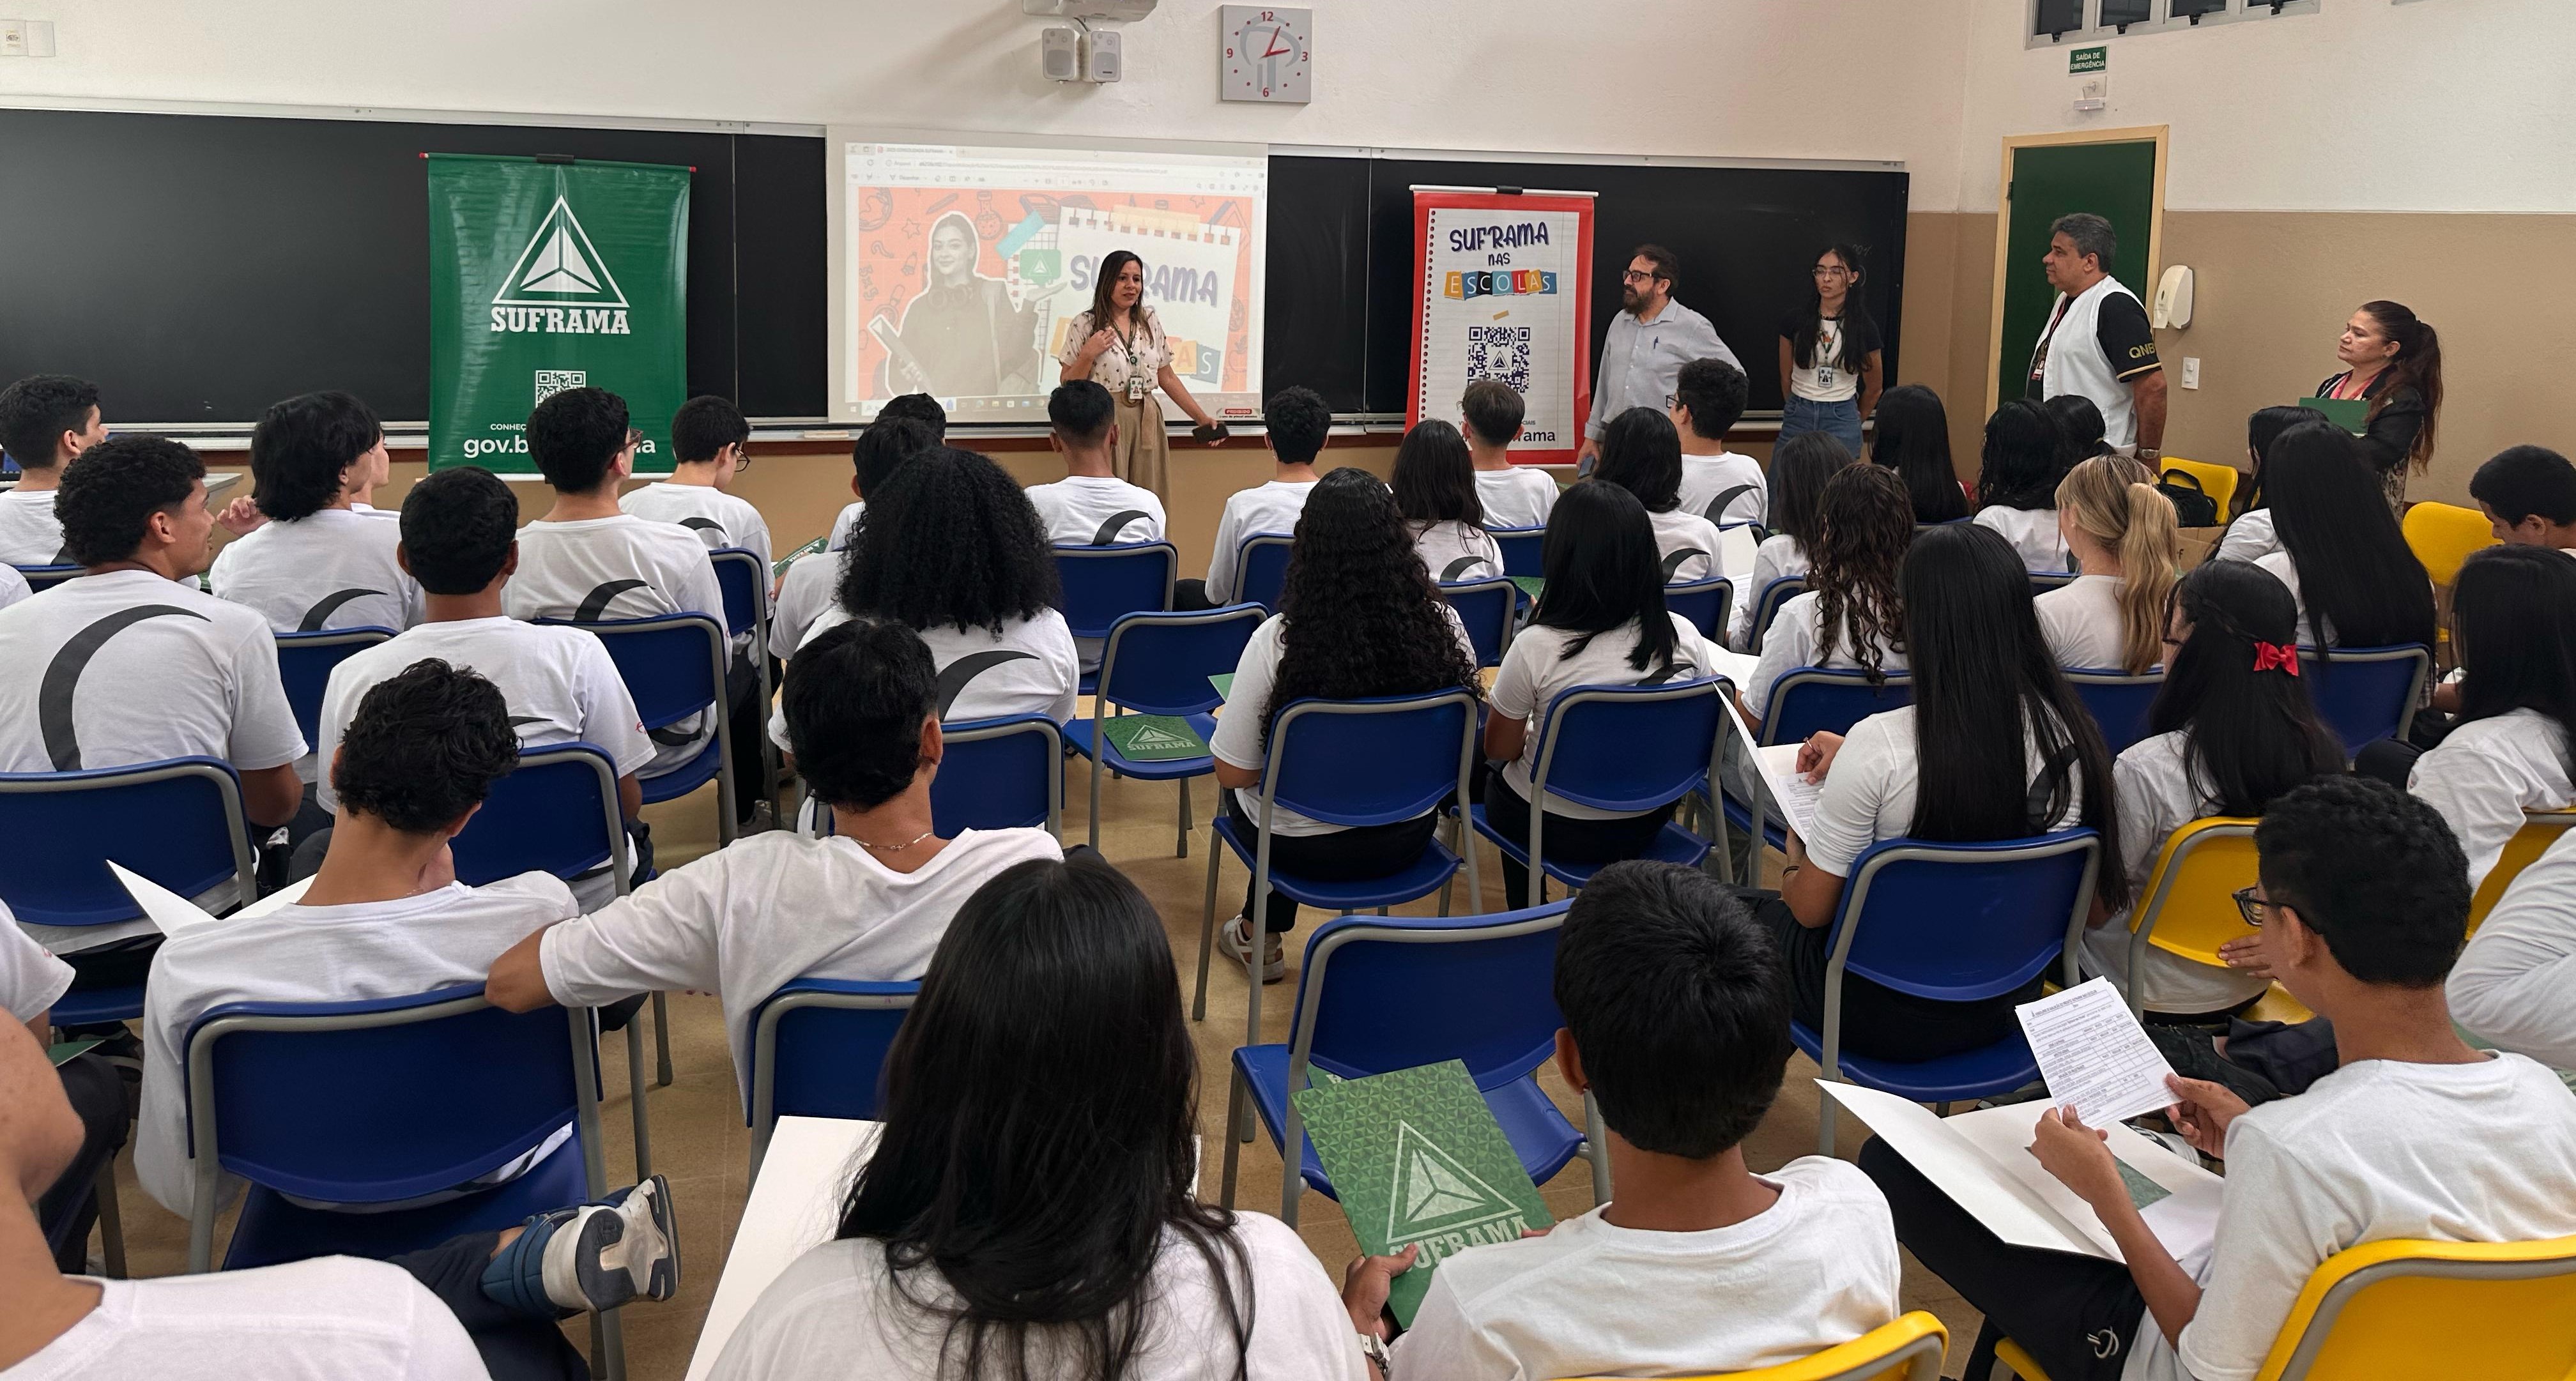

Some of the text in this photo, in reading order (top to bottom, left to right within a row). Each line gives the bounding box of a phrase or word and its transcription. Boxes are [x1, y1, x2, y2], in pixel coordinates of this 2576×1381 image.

[1261, 11, 1274, 22] 12
[1226, 48, 1308, 62] 9 3
[2075, 53, 2092, 61] SAÍDA
[2071, 60, 2105, 70] EMERGÊNCIA
[1262, 87, 1269, 97] 6
[1449, 222, 1549, 253] SUFRAMA
[1450, 273, 1551, 294] ESCOLAS
[491, 306, 631, 334] SUFRAMA
[490, 423, 526, 432] CONHEÇ
[1127, 741, 1196, 751] SUFRAMA
